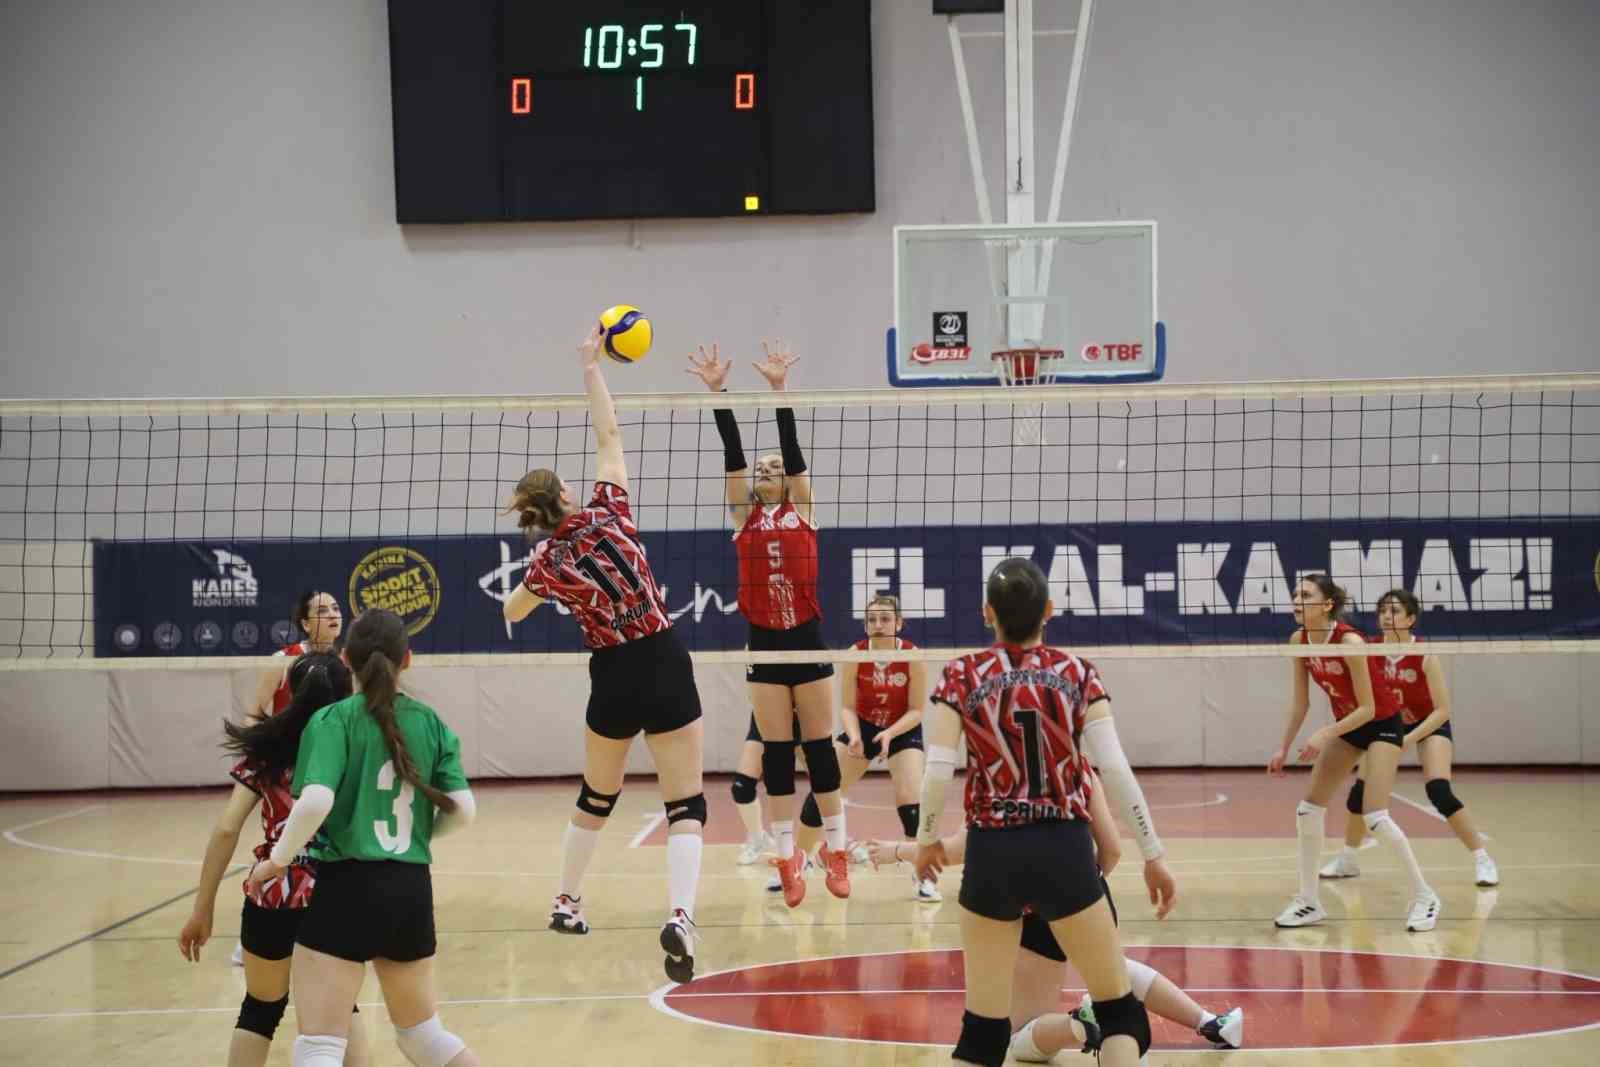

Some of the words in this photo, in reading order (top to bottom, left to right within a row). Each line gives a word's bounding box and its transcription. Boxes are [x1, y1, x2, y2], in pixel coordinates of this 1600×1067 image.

[583, 24, 697, 69] 10:57
[511, 79, 531, 113] 0
[635, 76, 644, 111] 1
[735, 74, 754, 108] 0
[1103, 344, 1143, 360] TBF
[574, 535, 642, 603] 11
[767, 540, 784, 569] 5
[191, 578, 258, 598] KADES
[852, 547, 945, 618] EL
[1013, 709, 1046, 798] 1
[373, 759, 416, 854] 3
